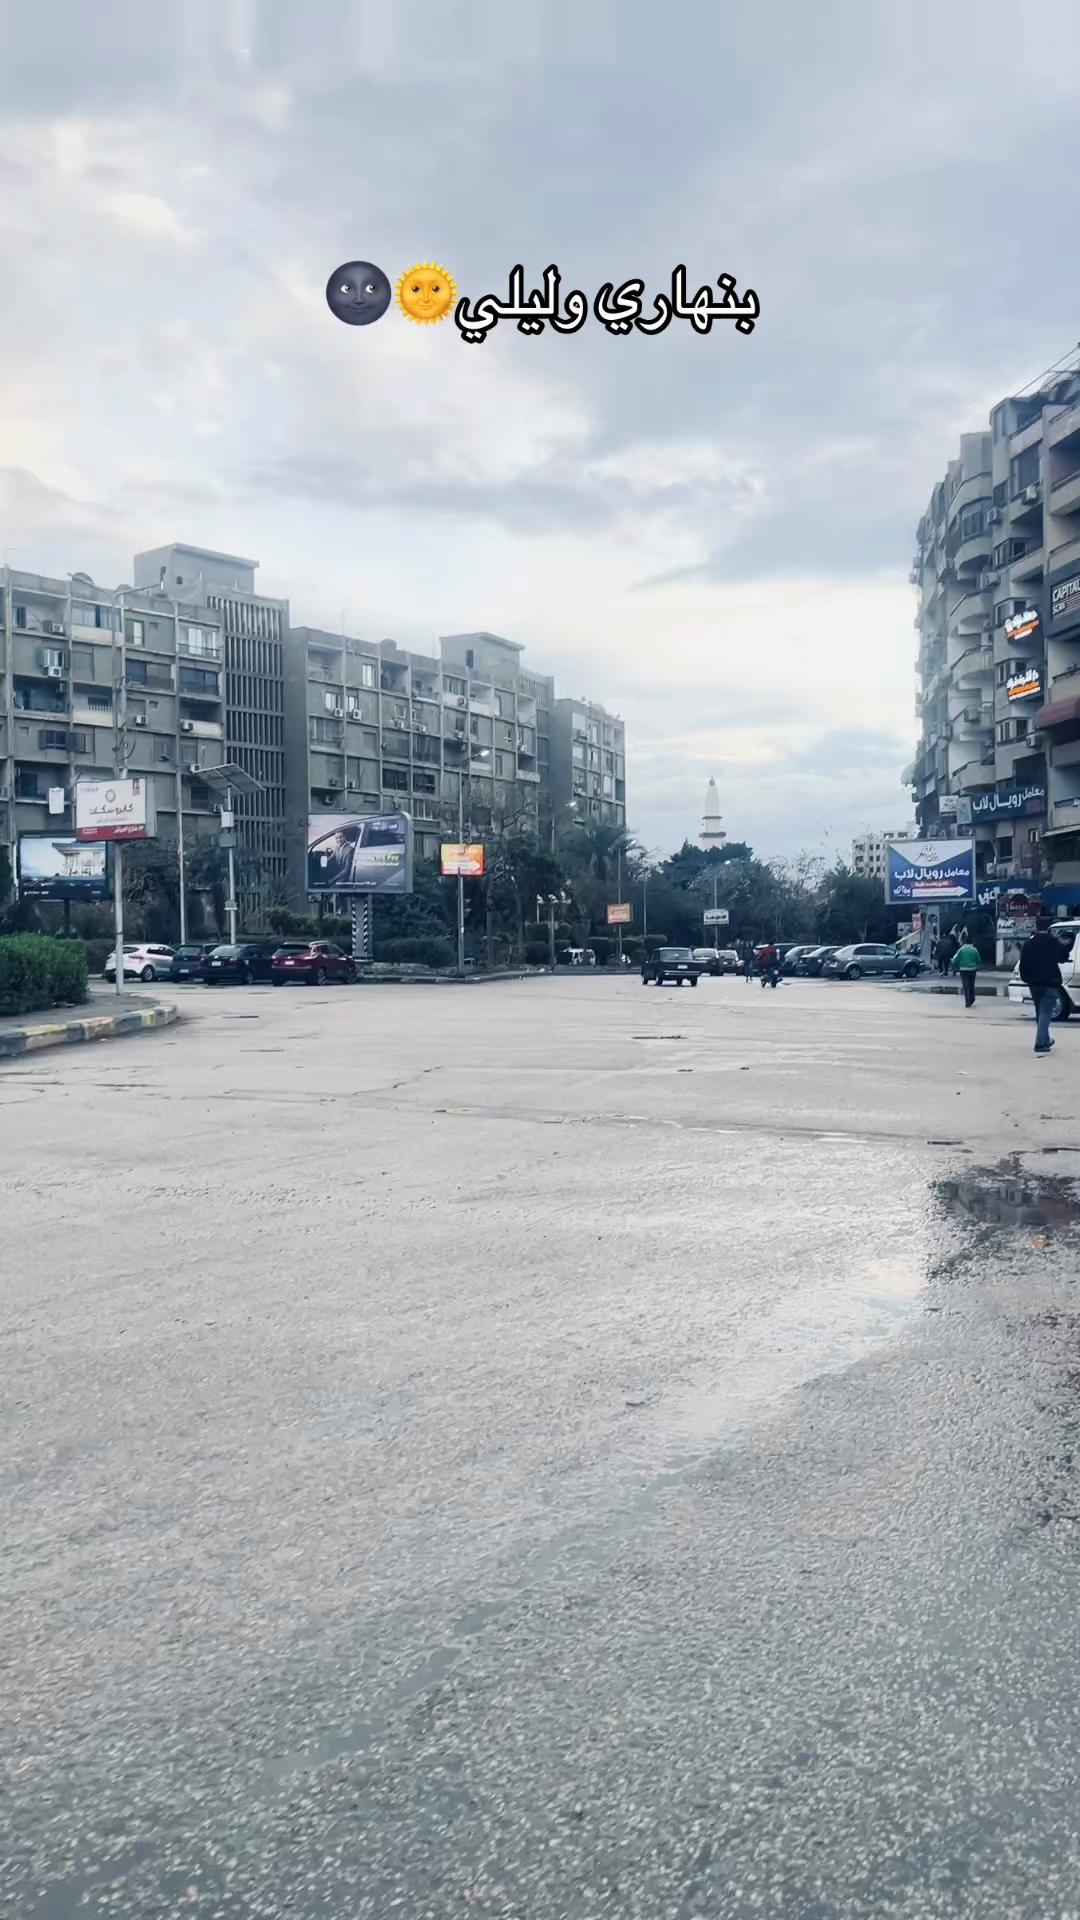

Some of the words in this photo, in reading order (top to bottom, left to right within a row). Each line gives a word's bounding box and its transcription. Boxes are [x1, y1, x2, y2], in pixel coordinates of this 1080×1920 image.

[1052, 579, 1080, 603] CAPITAL
[1022, 786, 1045, 801] معامل
[972, 795, 989, 813] لاب
[894, 868, 914, 882] لاب
[914, 867, 943, 881] رويال
[944, 868, 970, 878] معامل
